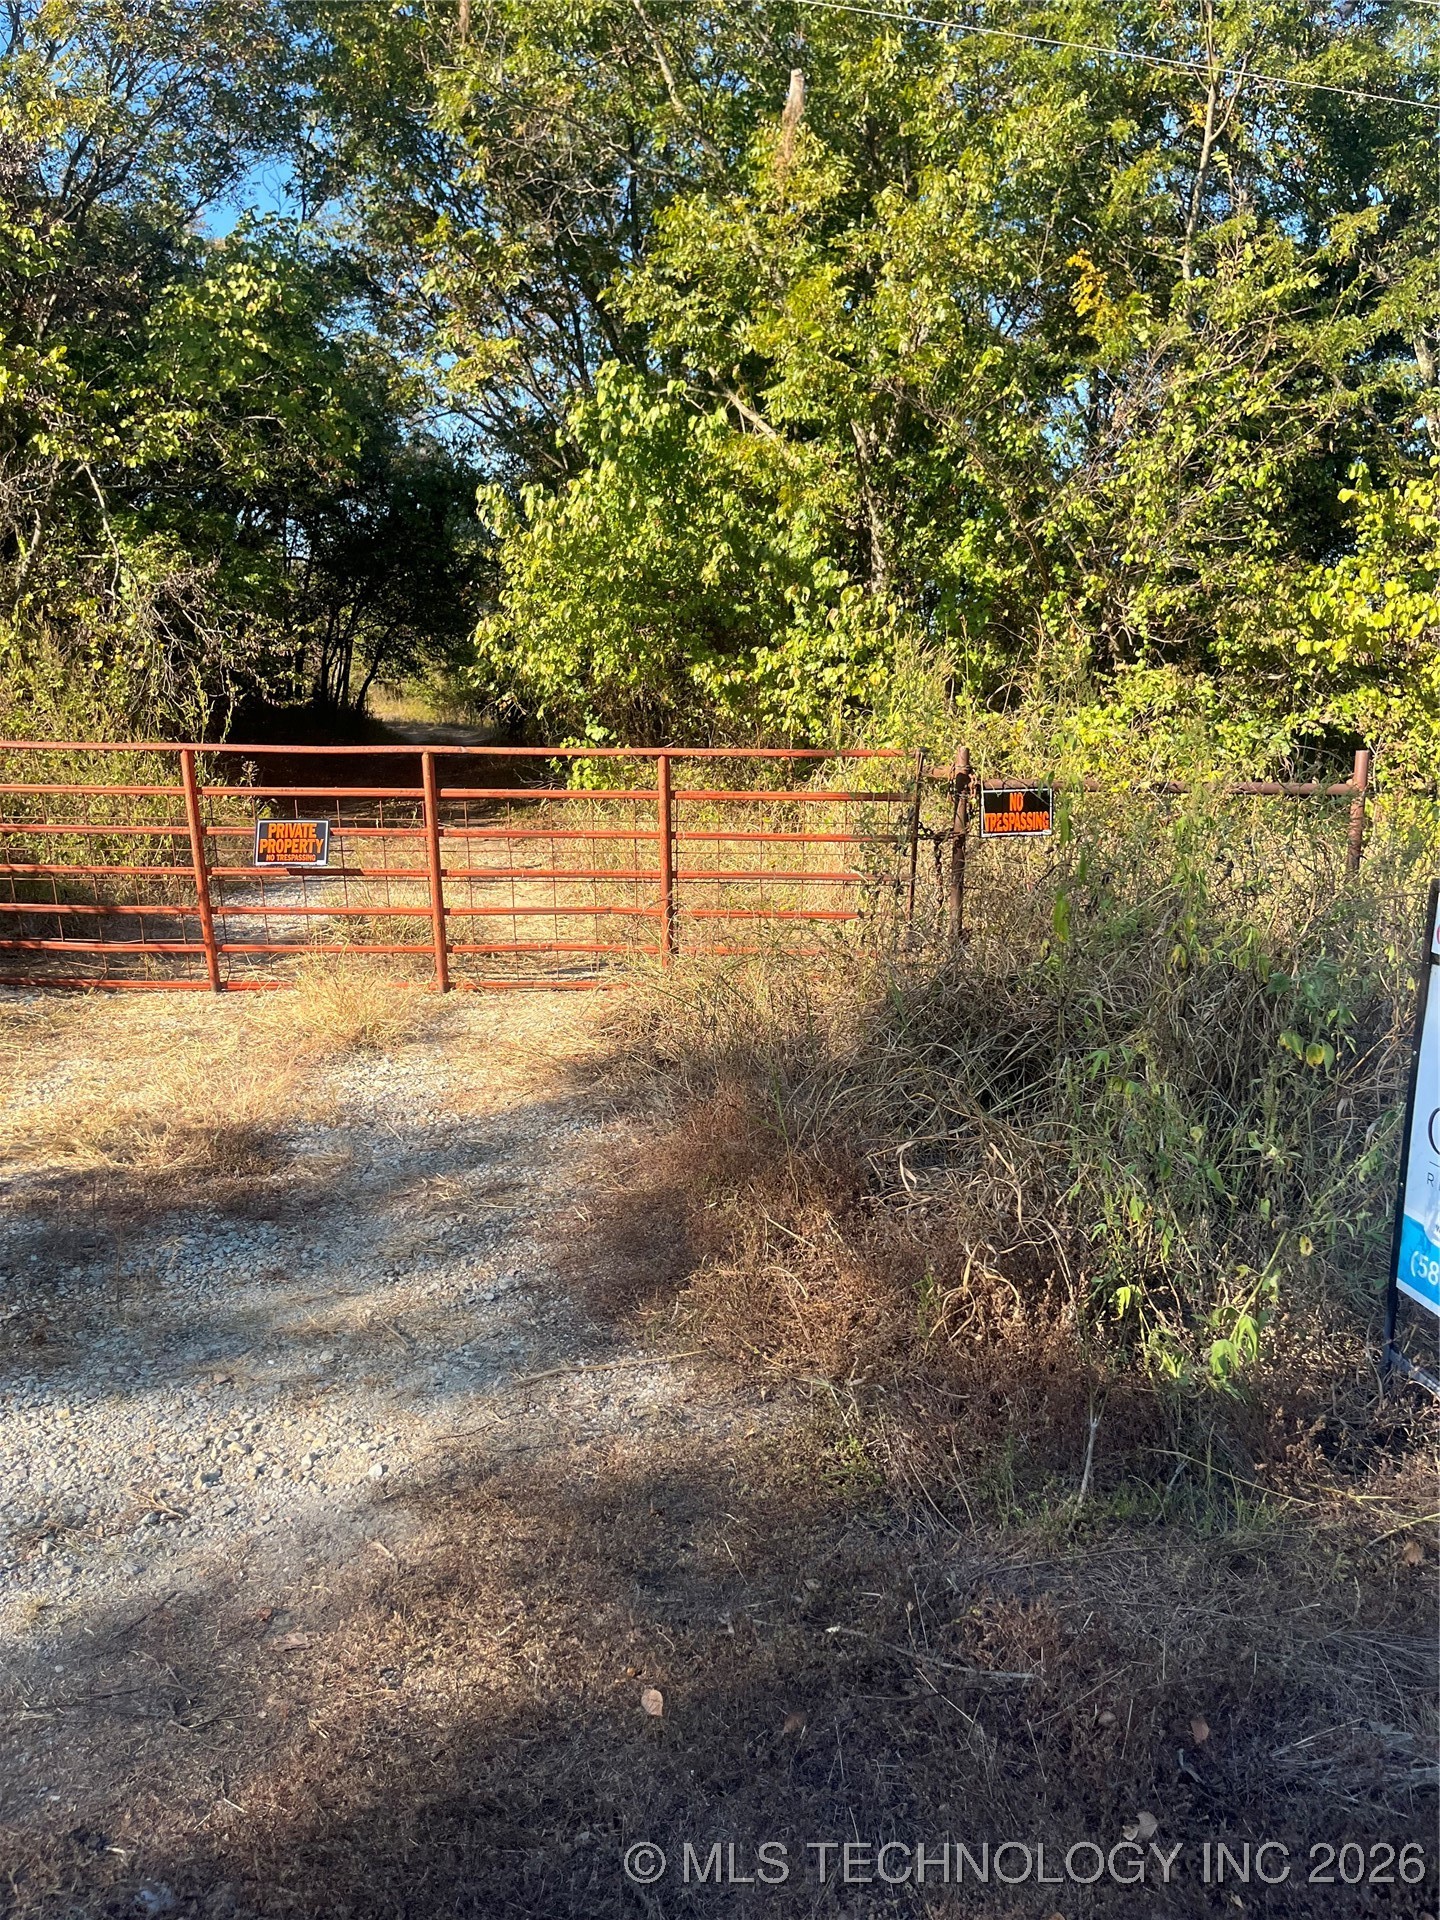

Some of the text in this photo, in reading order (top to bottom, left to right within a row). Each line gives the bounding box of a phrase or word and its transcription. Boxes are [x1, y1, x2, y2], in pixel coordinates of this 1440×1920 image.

[1009, 792, 1024, 811] NO
[985, 811, 1049, 832] TRESPASSING
[268, 823, 317, 838] PRIVATE
[259, 838, 324, 853] PROPERTY
[277, 853, 316, 861] TRESPASSING
